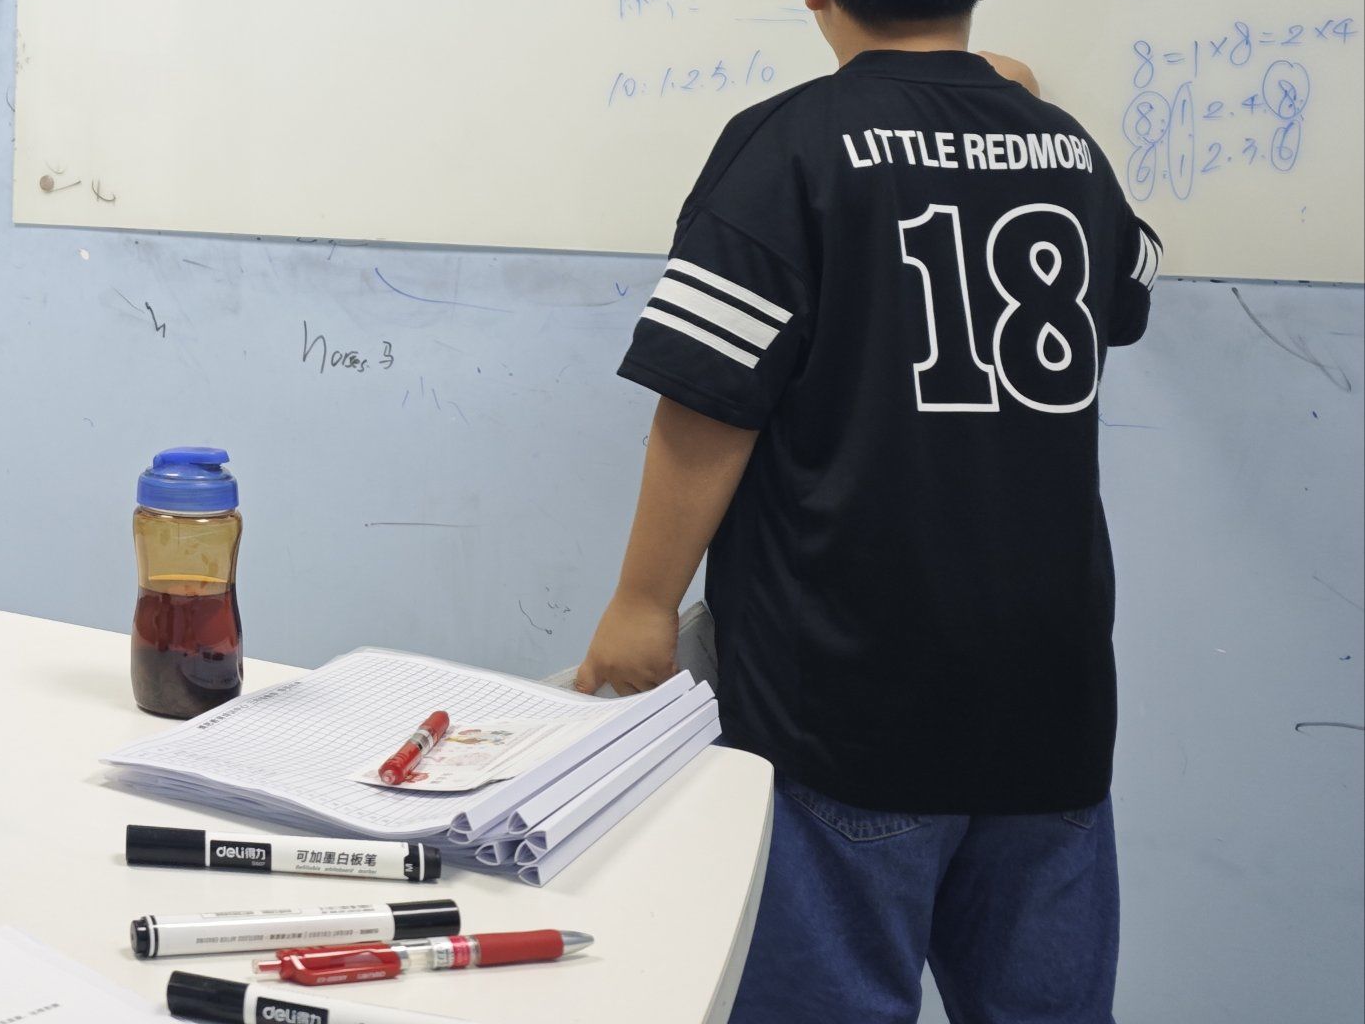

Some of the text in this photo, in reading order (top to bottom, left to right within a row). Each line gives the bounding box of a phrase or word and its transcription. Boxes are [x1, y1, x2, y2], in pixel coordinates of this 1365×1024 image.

[842, 127, 959, 169] LITTLE
[898, 203, 1099, 414] 18
[296, 849, 378, 867] 可加墨白板笔
